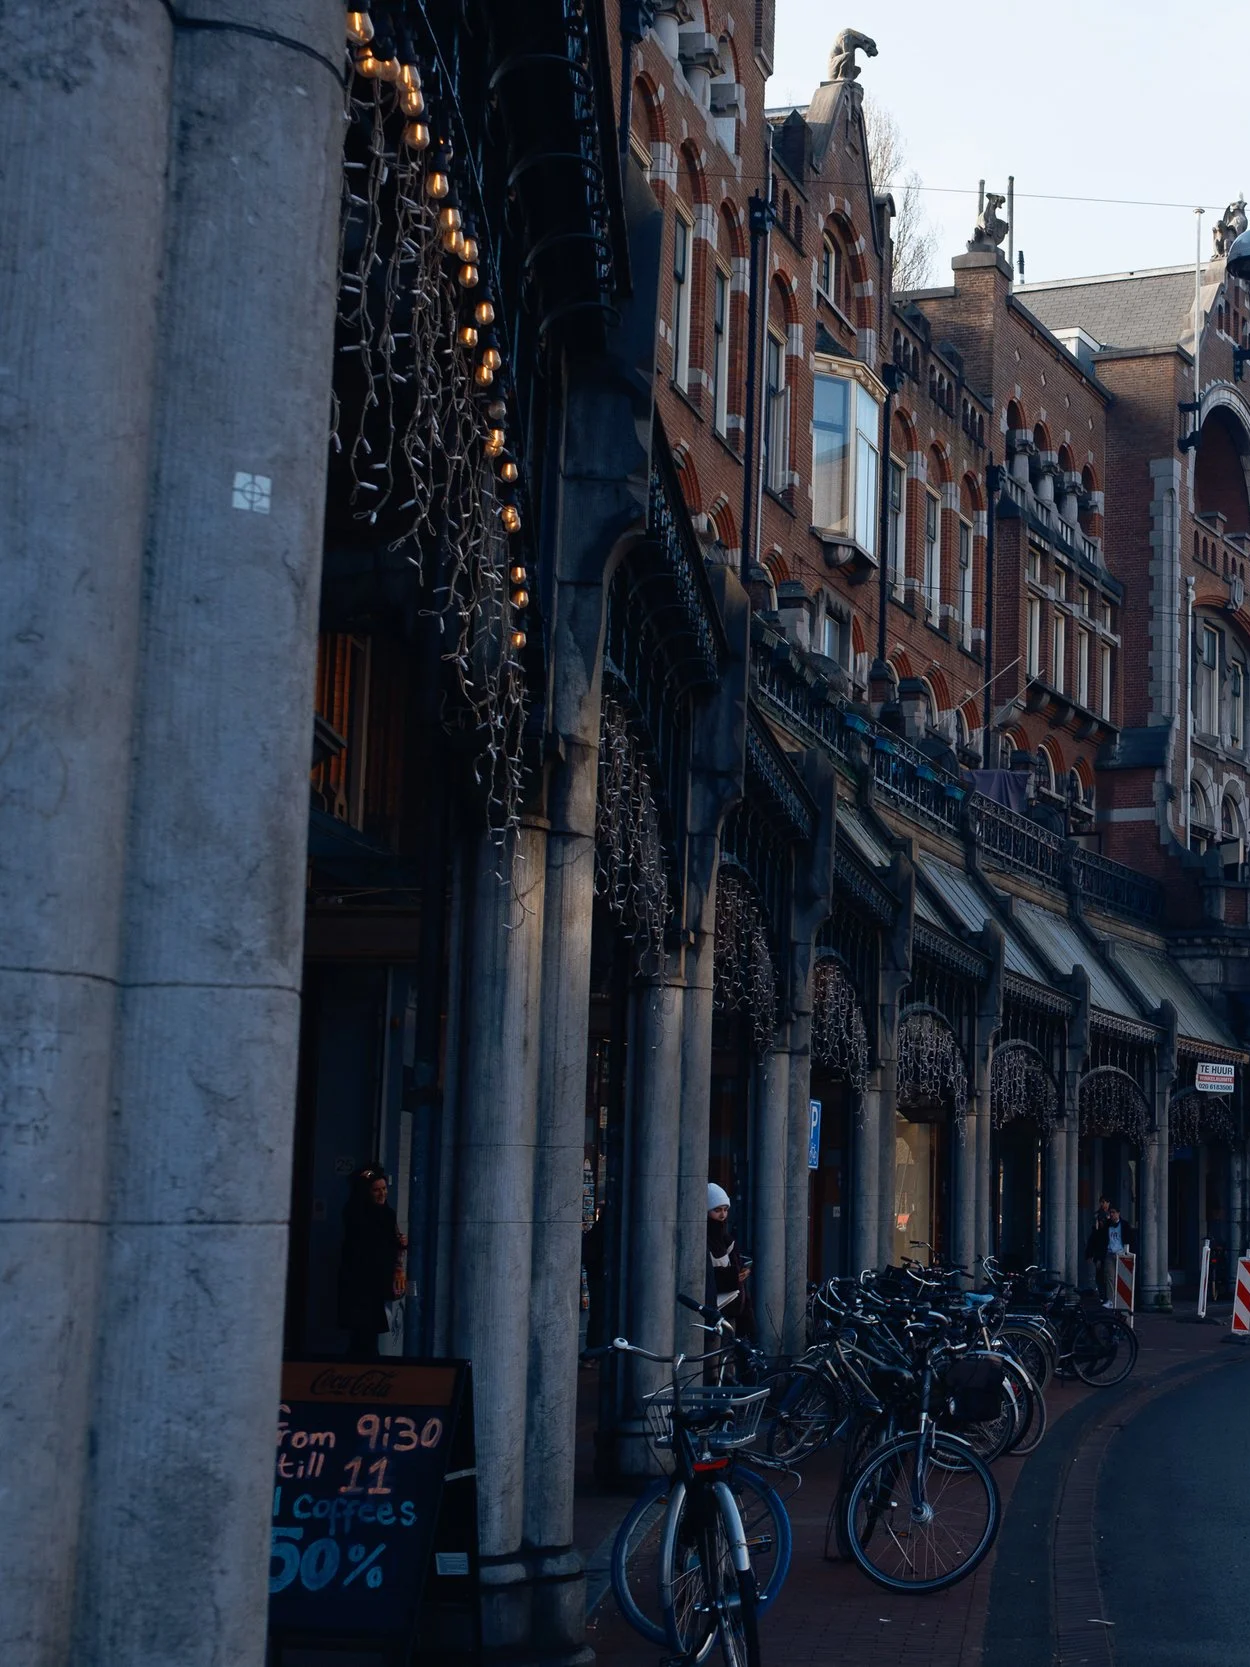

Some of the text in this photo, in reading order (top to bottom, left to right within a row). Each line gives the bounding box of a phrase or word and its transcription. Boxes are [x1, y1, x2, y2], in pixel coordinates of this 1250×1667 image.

[1200, 1064, 1233, 1075] TE HUUR
[811, 1106, 818, 1139] P
[336, 1159, 353, 1172] 25
[356, 1413, 442, 1452] 9:30
[278, 1451, 391, 1495] till 11
